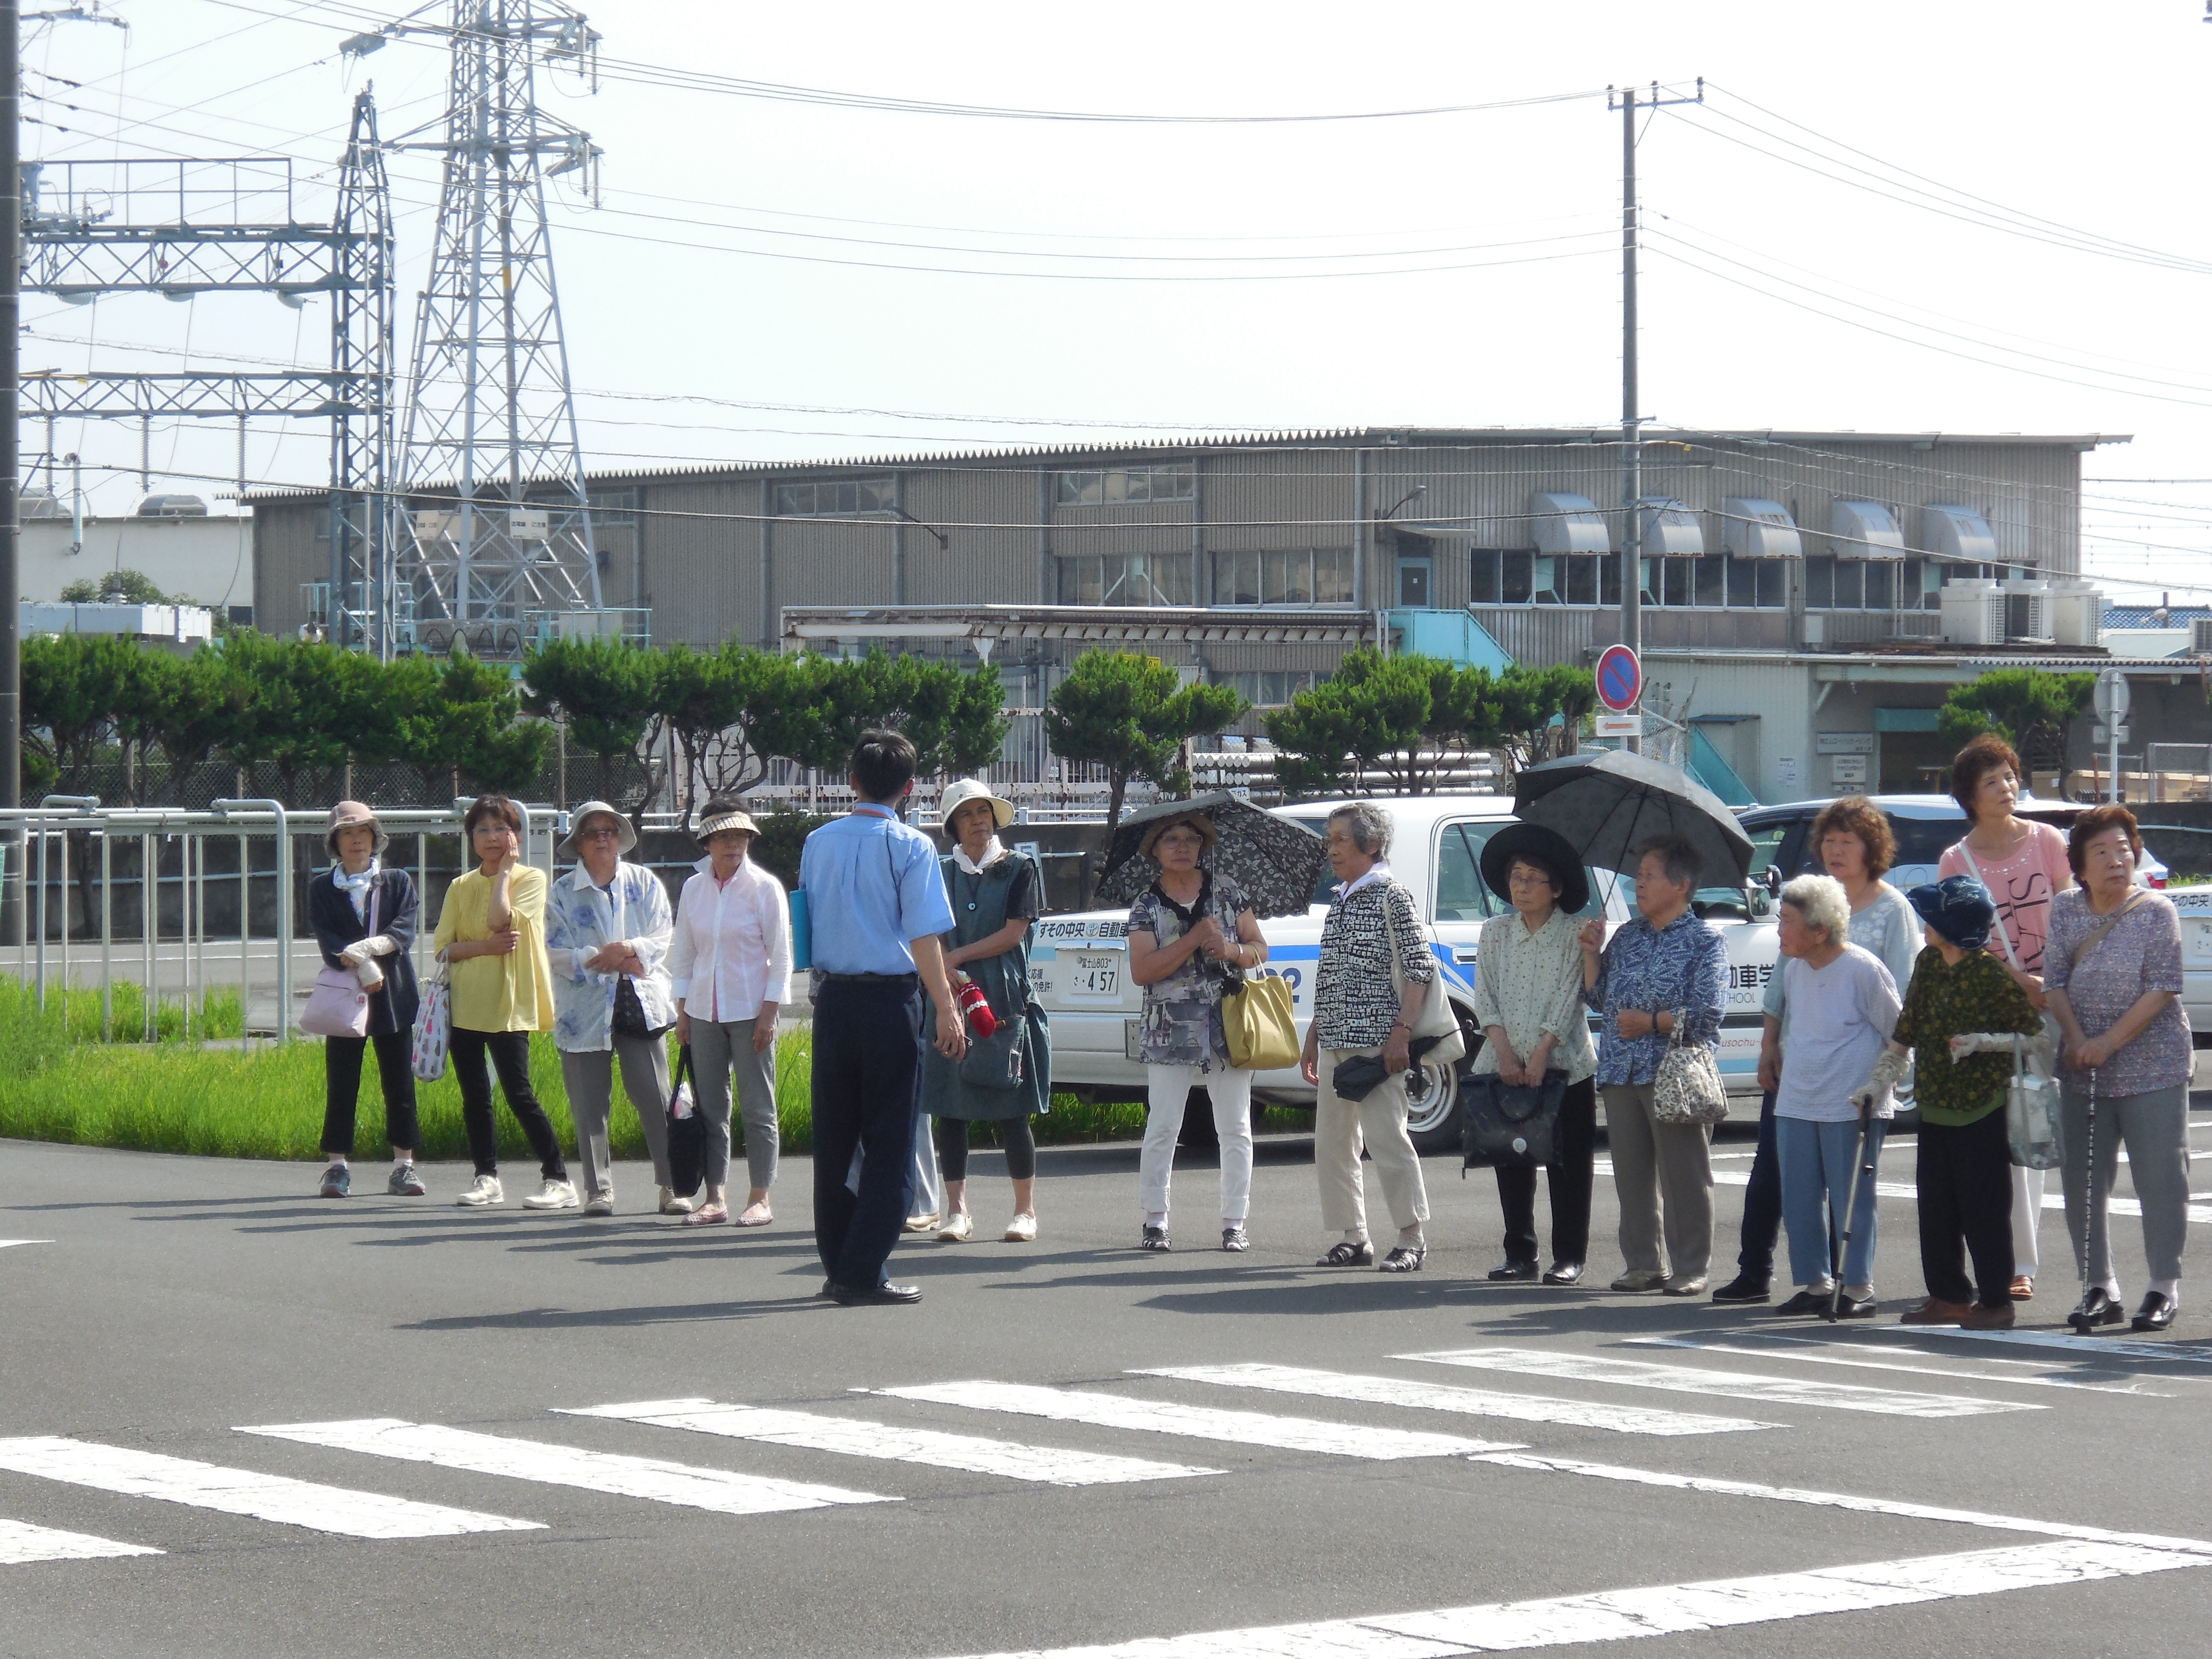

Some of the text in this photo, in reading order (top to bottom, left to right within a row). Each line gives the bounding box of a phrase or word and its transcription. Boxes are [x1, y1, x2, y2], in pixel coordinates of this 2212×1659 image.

[1040, 921, 1129, 938] すその中央 自動車
[1032, 981, 1053, 992] の免許!
